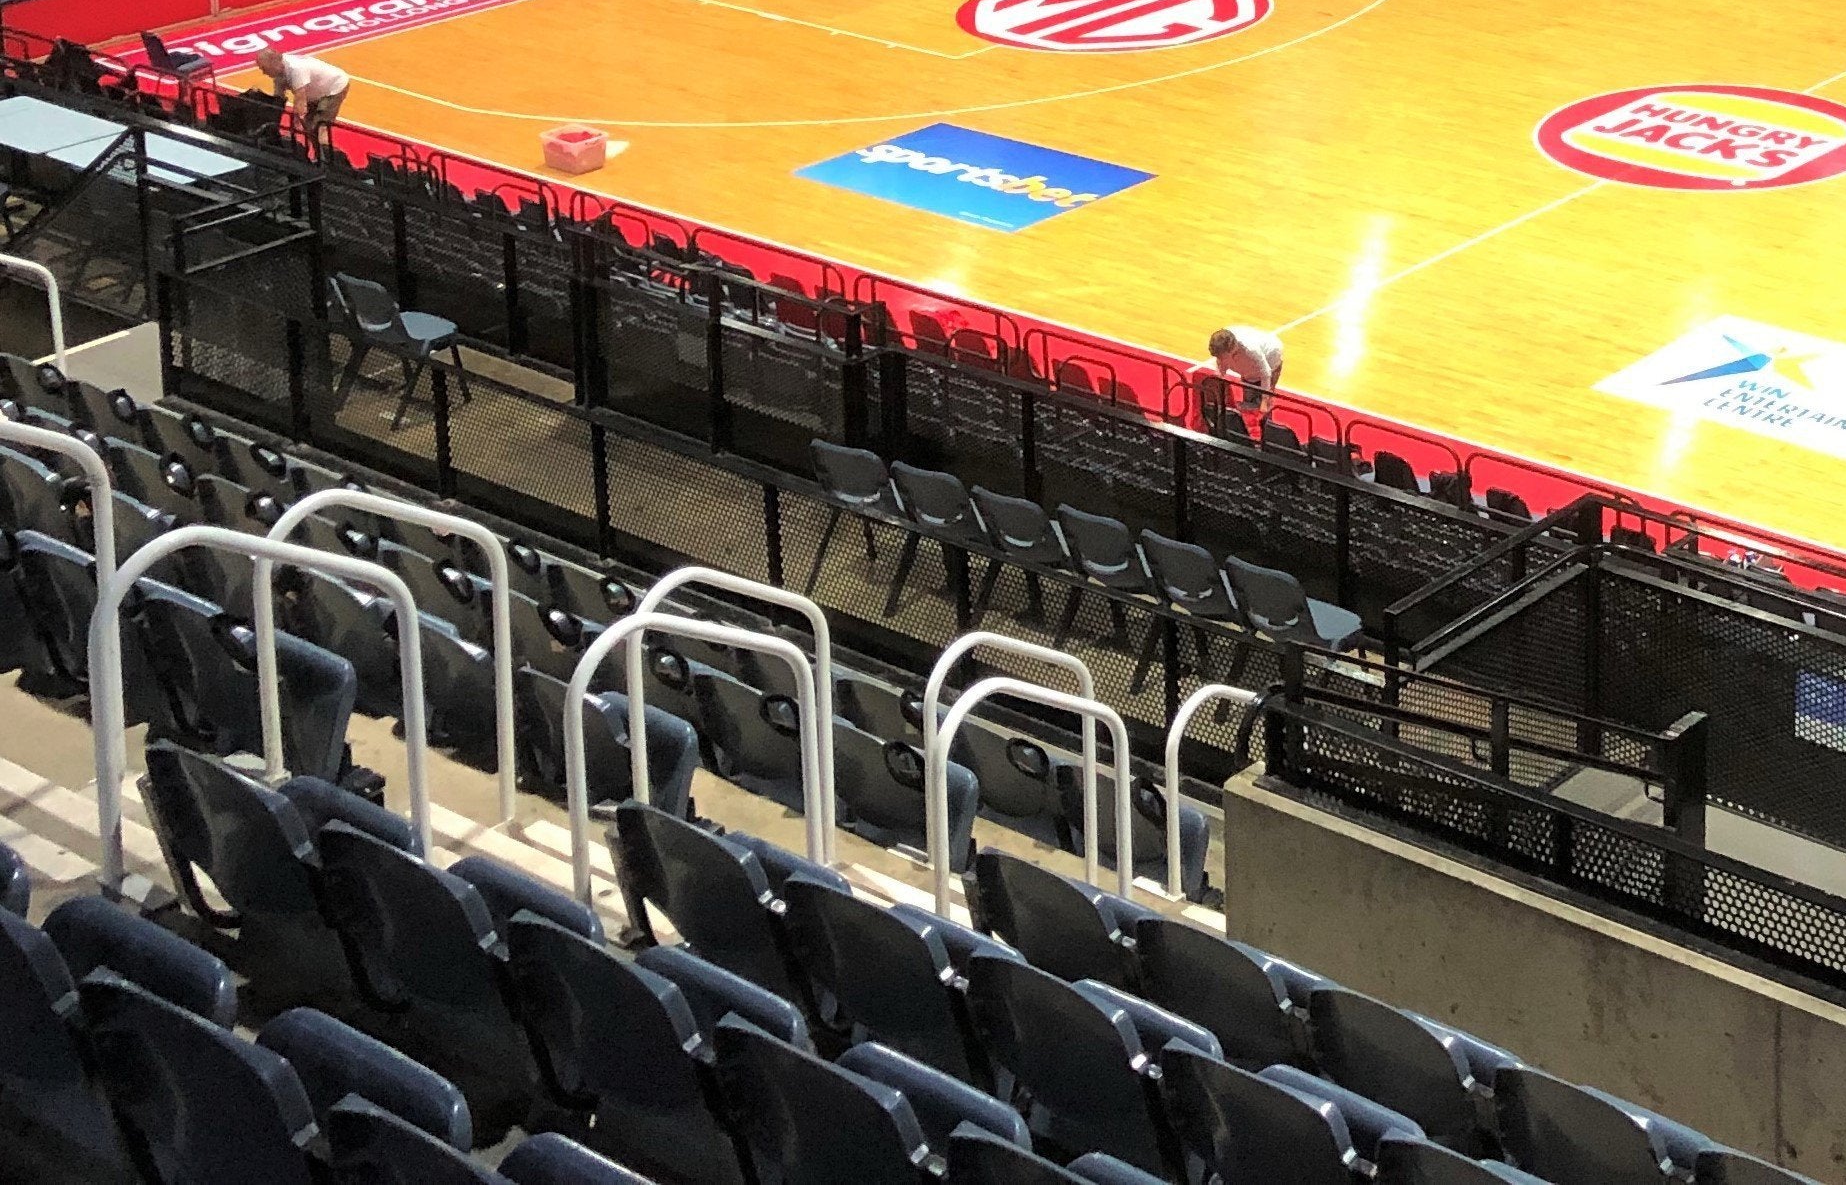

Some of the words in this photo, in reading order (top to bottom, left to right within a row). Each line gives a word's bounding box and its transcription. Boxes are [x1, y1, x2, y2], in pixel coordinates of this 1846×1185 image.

[1593, 118, 1800, 168] JACK'S
[1630, 103, 1828, 149] HUNGRY
[856, 144, 1100, 208] sportsbet
[1738, 380, 1791, 399] WIN
[1703, 398, 1793, 428] CENTRE
